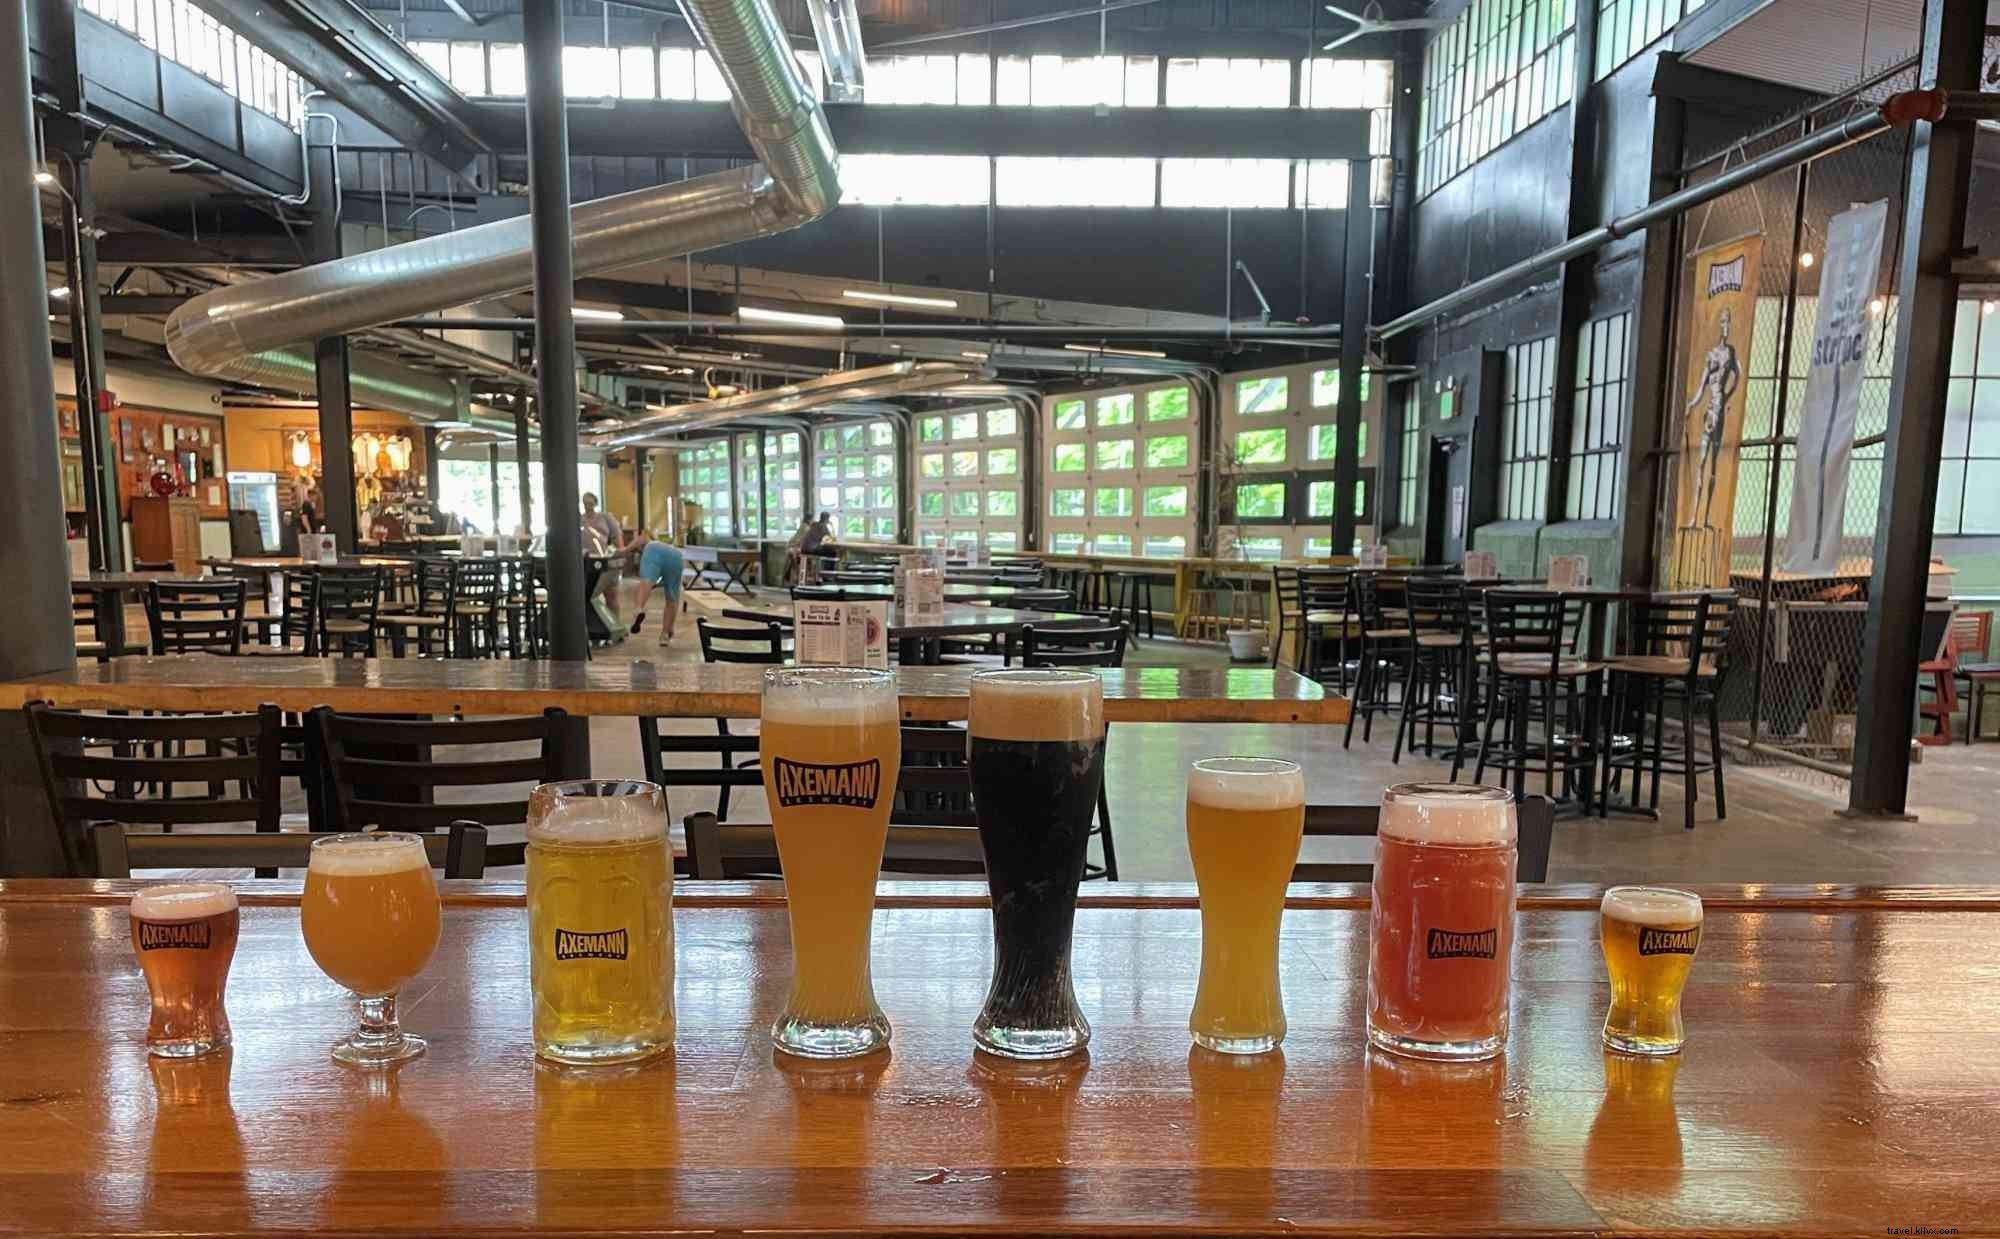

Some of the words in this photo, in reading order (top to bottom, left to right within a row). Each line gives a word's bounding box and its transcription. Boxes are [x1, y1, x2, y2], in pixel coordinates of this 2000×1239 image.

[780, 762, 877, 799] AXEMANN
[142, 924, 208, 945] AXEMANN
[559, 931, 625, 954] AXEMANN
[1431, 931, 1495, 953] AXEMANN
